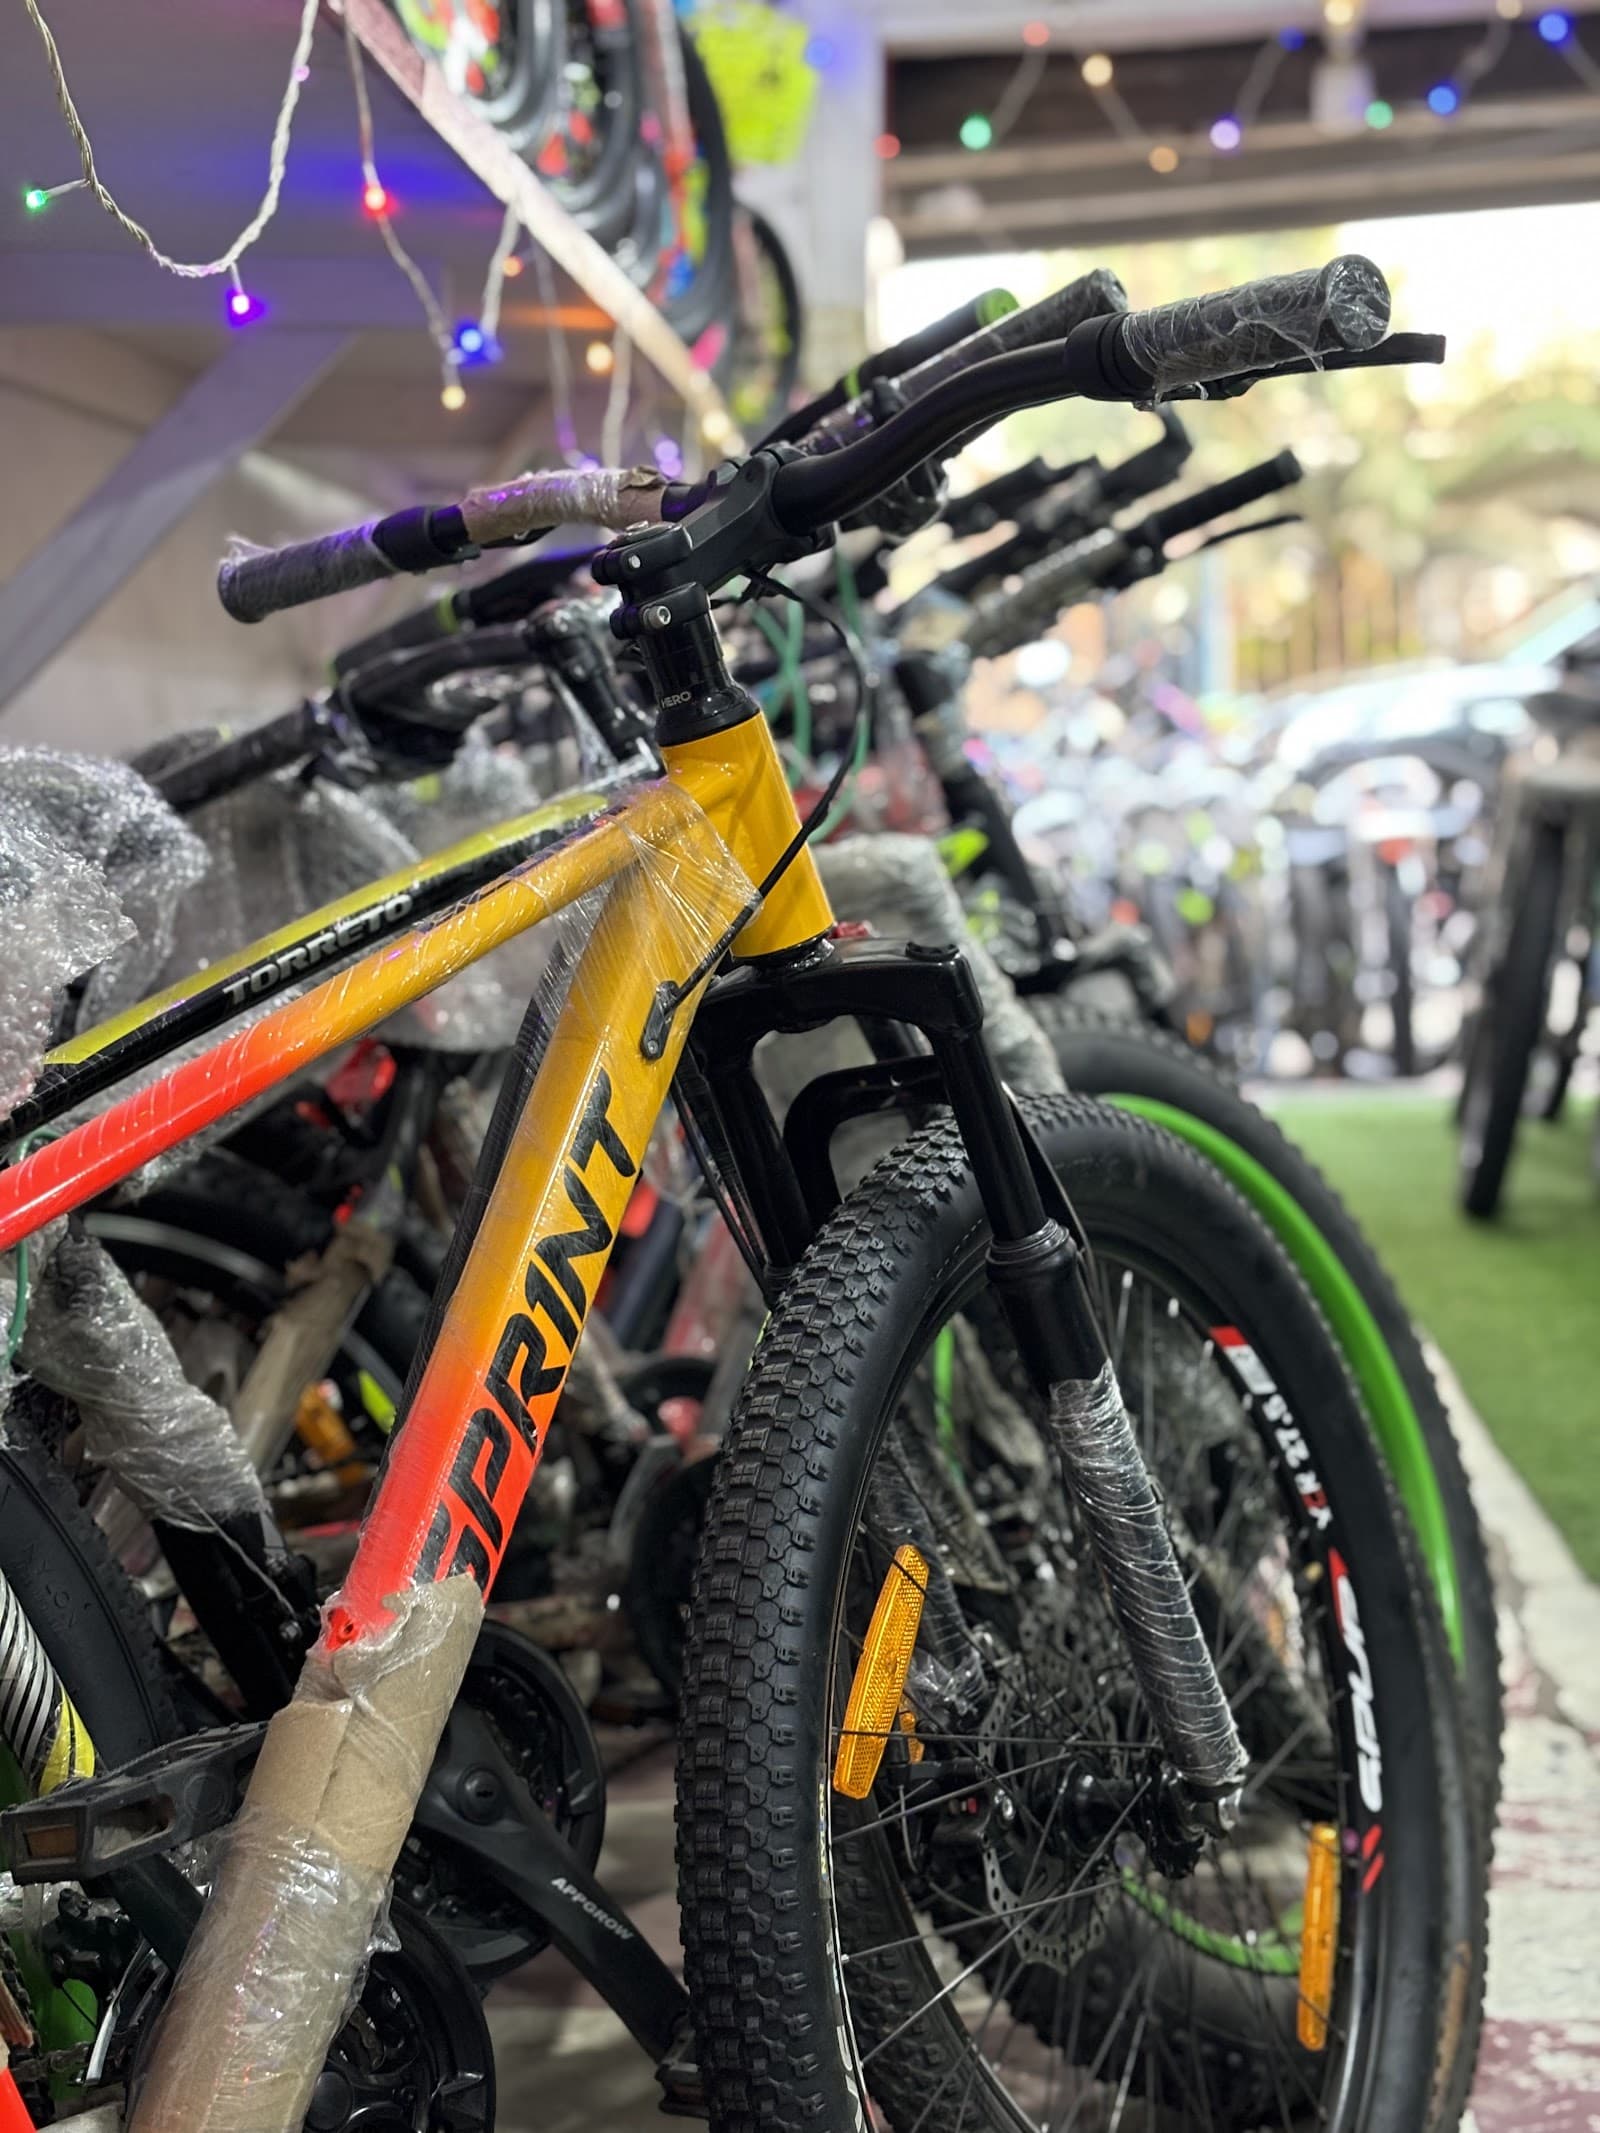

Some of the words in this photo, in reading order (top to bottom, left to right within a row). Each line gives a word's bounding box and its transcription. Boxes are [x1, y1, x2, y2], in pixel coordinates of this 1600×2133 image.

[223, 894, 413, 1005] TORRETO
[414, 1067, 636, 1588] SPRINT
[551, 1877, 633, 1939] APPGROW
